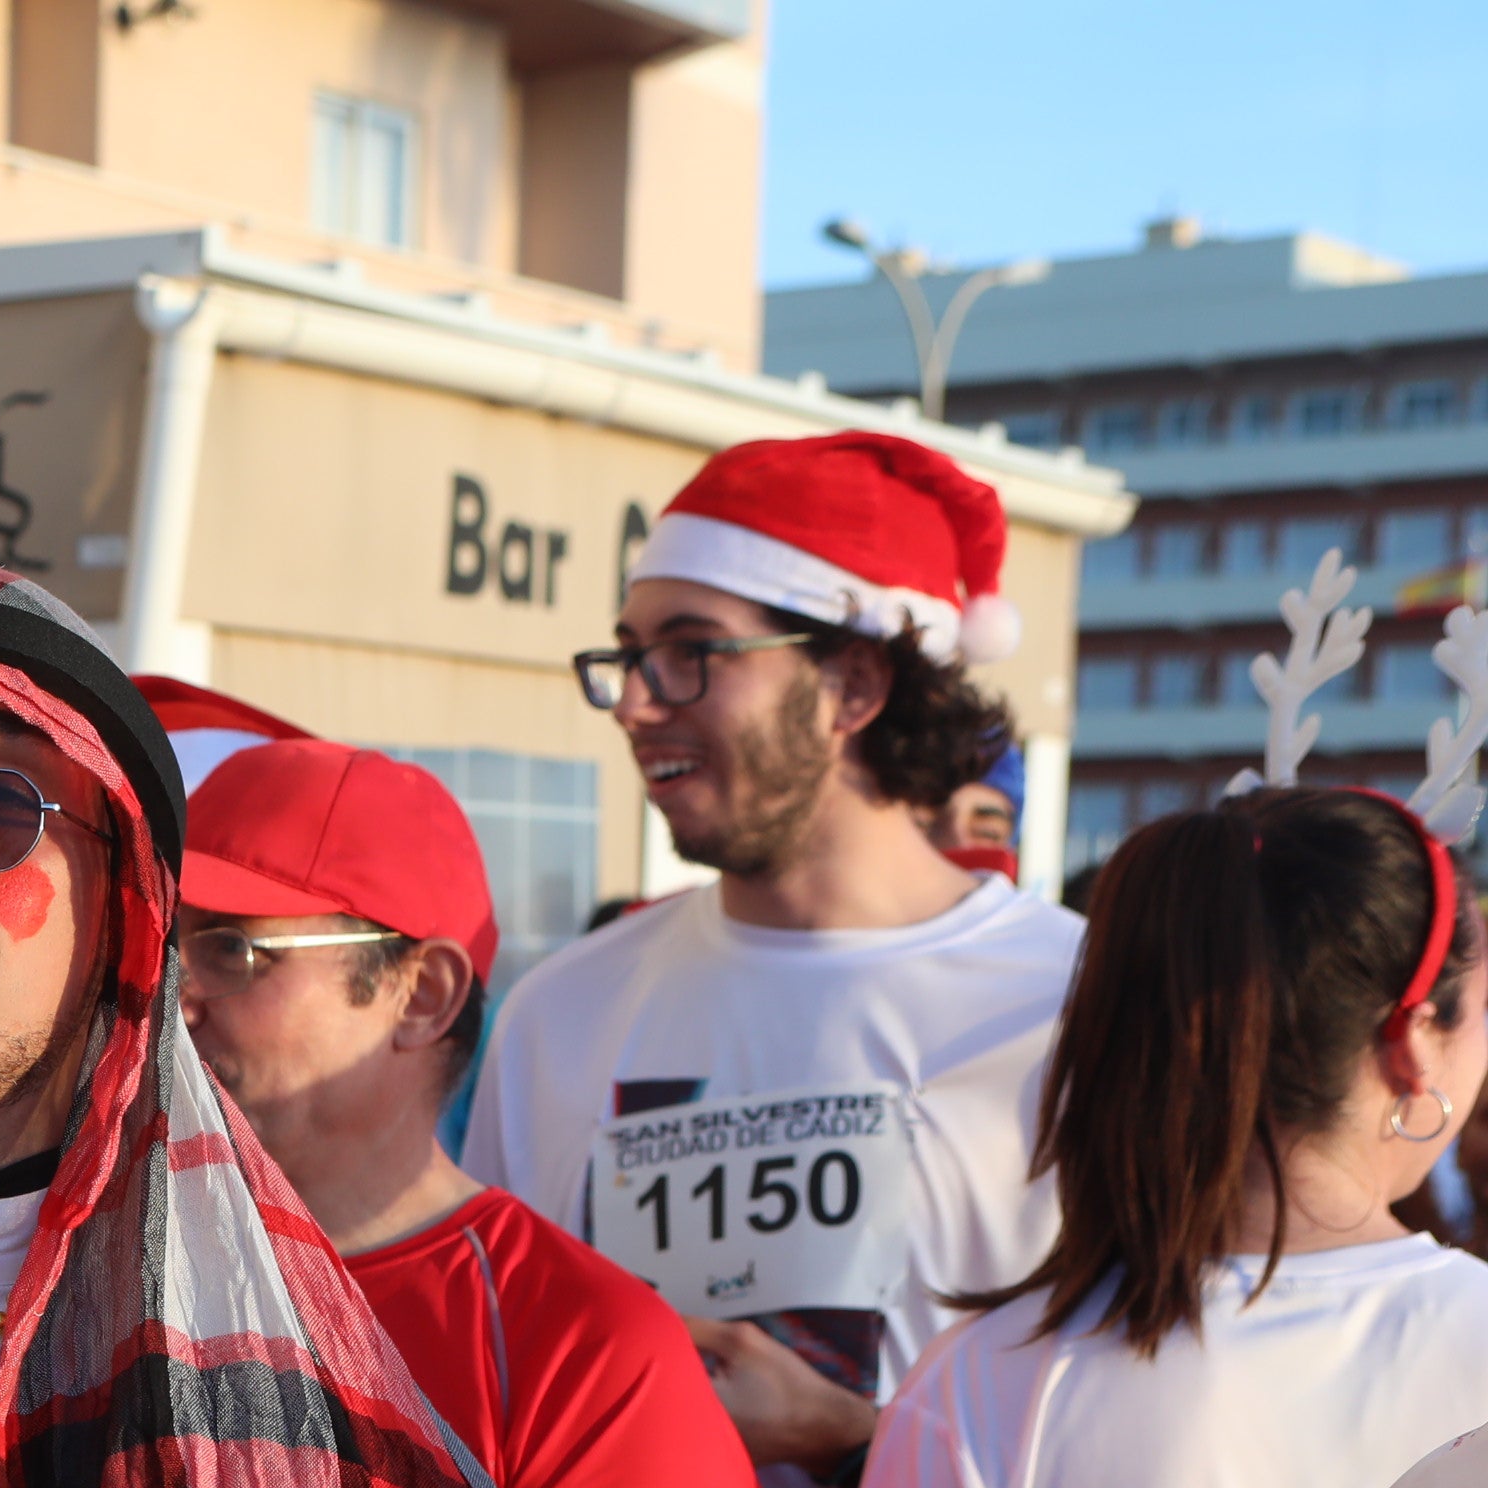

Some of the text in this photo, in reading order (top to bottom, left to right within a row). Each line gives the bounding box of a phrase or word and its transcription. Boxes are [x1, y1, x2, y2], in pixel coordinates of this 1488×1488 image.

[445, 471, 570, 607] Bar
[614, 1092, 886, 1144] SAN SILVESTRE
[616, 1129, 728, 1170] CIUDAD
[735, 1123, 774, 1149] DE
[635, 1149, 862, 1252] 1150
